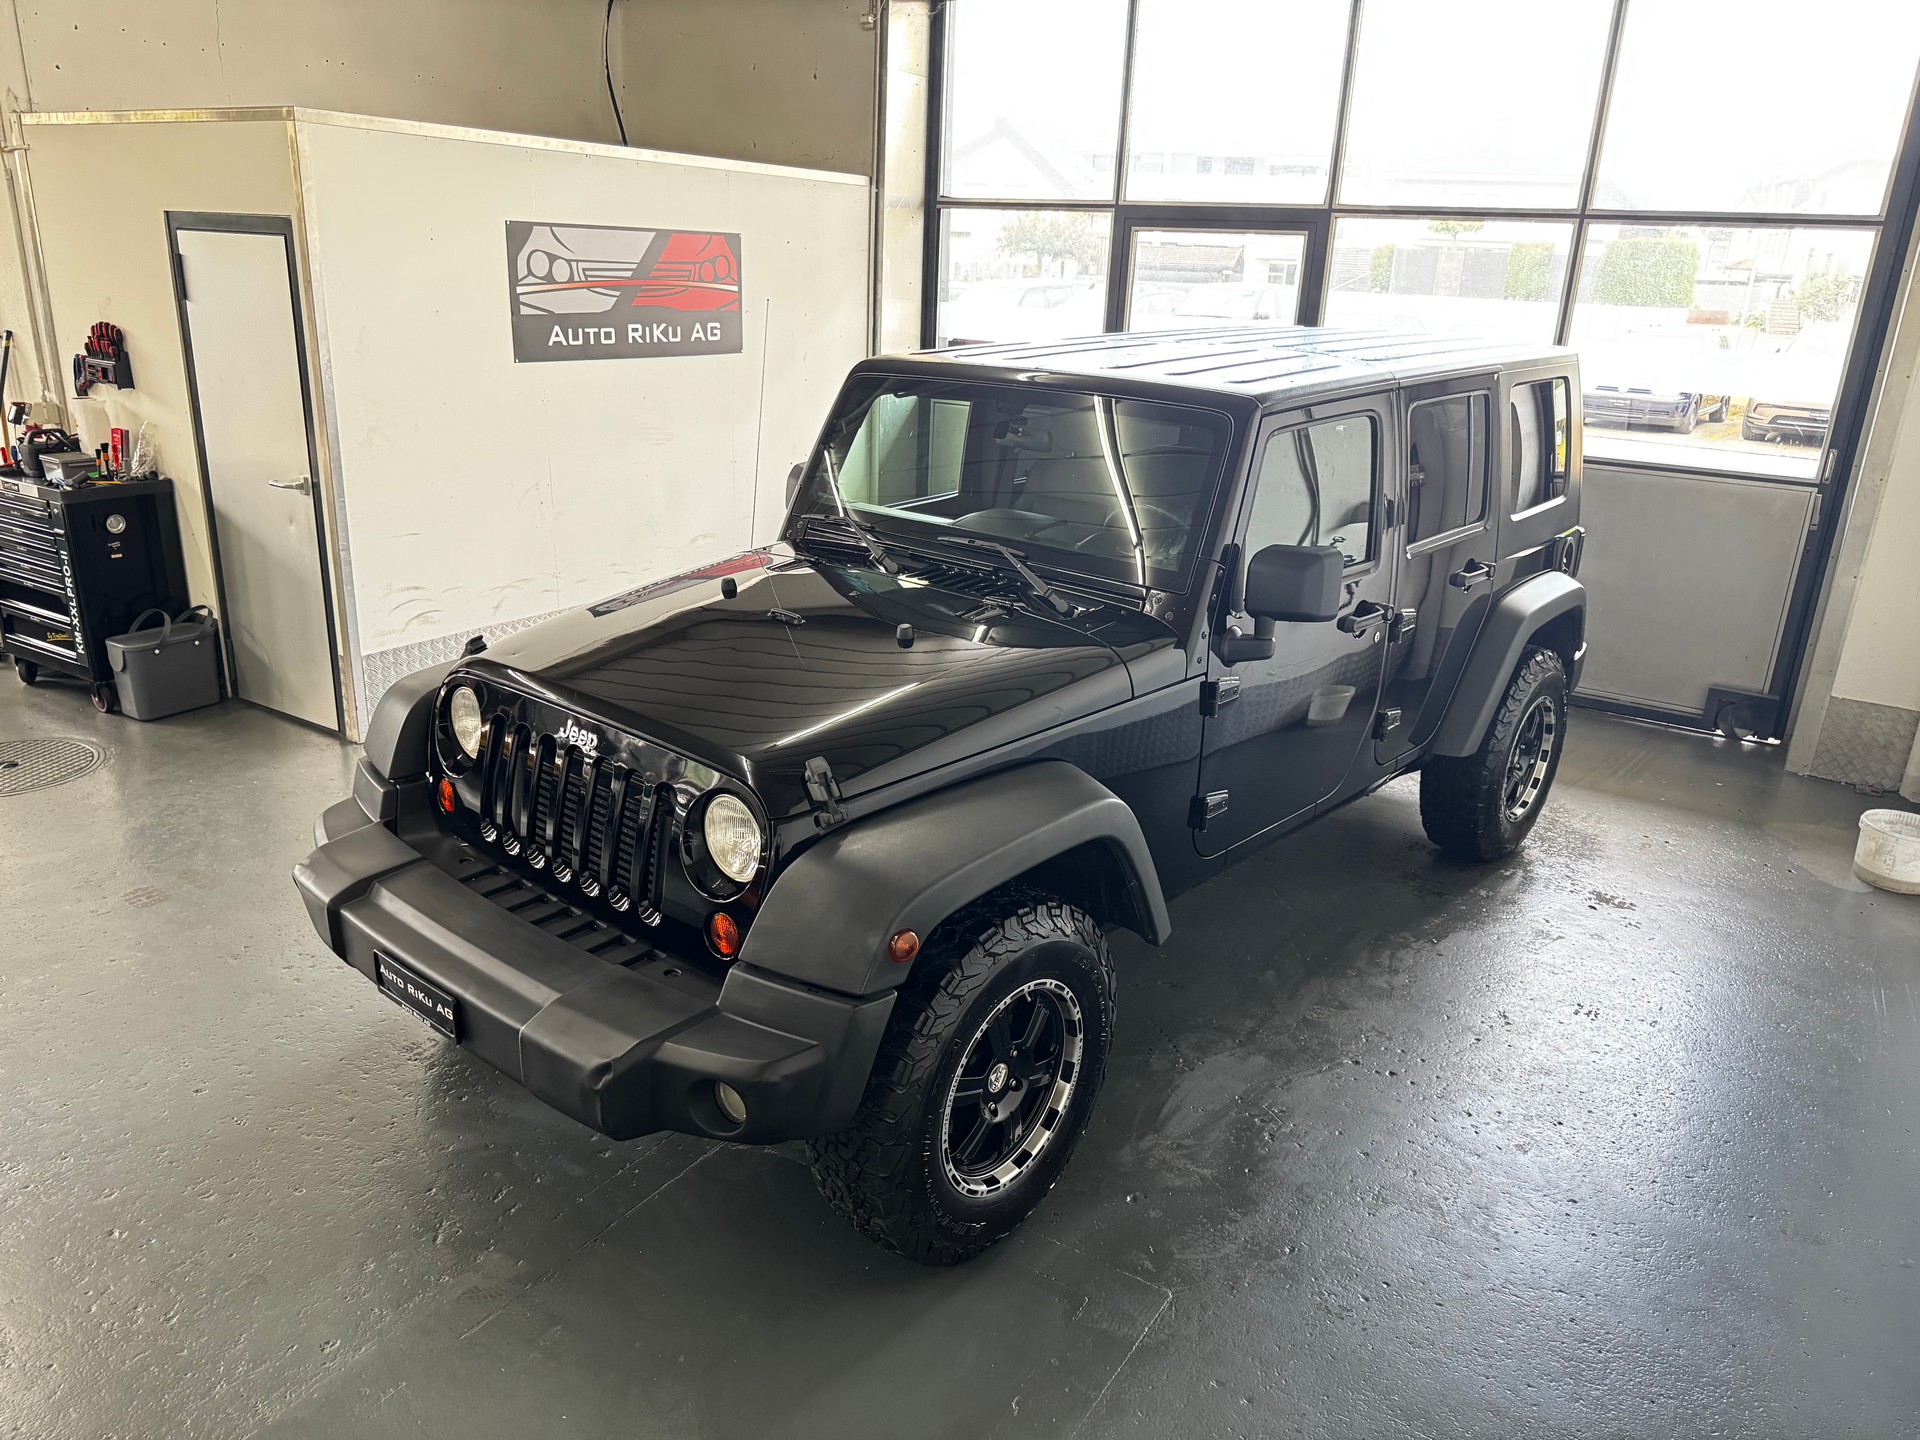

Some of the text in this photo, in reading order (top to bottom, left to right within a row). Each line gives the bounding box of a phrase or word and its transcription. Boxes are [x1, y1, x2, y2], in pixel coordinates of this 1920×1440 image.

[548, 325, 616, 346] AUTO
[690, 322, 721, 341] AG
[559, 719, 599, 750] Jeep
[380, 964, 405, 989] AUTO
[436, 1003, 454, 1020] AG
